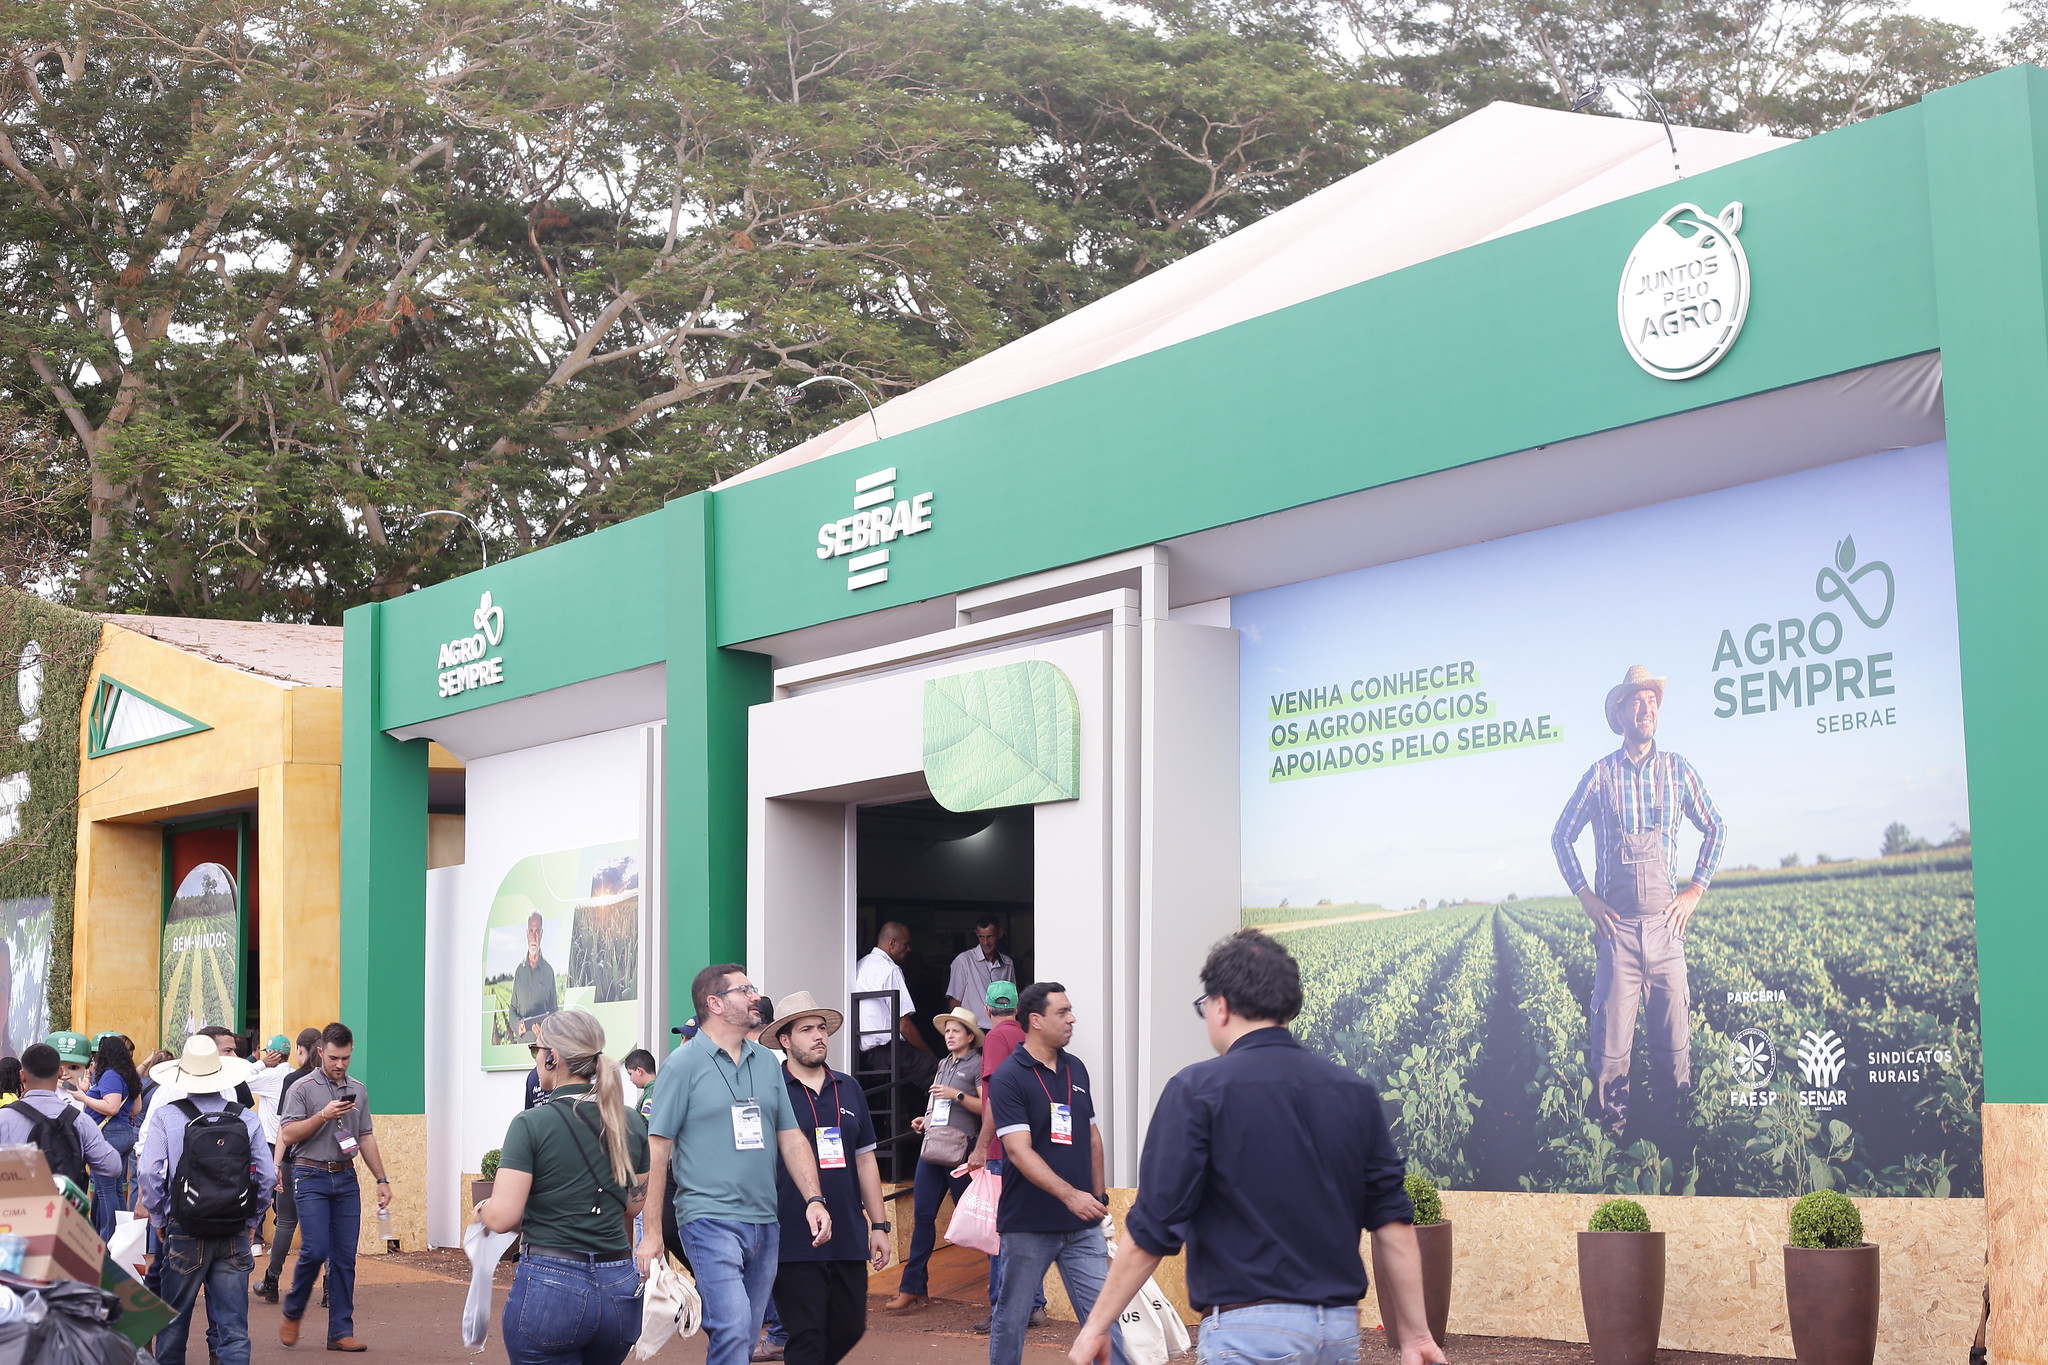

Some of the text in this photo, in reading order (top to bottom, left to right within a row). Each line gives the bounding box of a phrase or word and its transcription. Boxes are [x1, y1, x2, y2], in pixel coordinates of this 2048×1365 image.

[1636, 255, 1719, 296] JUNTOS
[1663, 281, 1709, 307] PELO
[1640, 299, 1722, 344] AGRO
[816, 491, 934, 560] SEBRAE
[437, 633, 487, 669] AGRO
[1711, 611, 1843, 672] AGRO
[438, 657, 504, 698] SEMPRE
[1270, 660, 1475, 716] VENHA CONHECER
[1713, 652, 1895, 719] SEMPRE
[1271, 691, 1488, 747] OS AGRONEGÓCIOS
[1816, 707, 1897, 734] SEBRAE
[1271, 714, 1558, 778] APOIADOS PELO SEBRAE.
[172, 931, 227, 952] BEM-VINDOS
[1727, 989, 1787, 1004] PARCERIA
[1868, 1050, 1953, 1065] SINDICATOS
[1869, 1070, 1920, 1083] RURAIS
[1730, 1091, 1778, 1107] FAESP
[1799, 1090, 1848, 1106] SENAR
[0, 1171, 27, 1182] GIL.
[2, 1208, 27, 1218] CIMA
